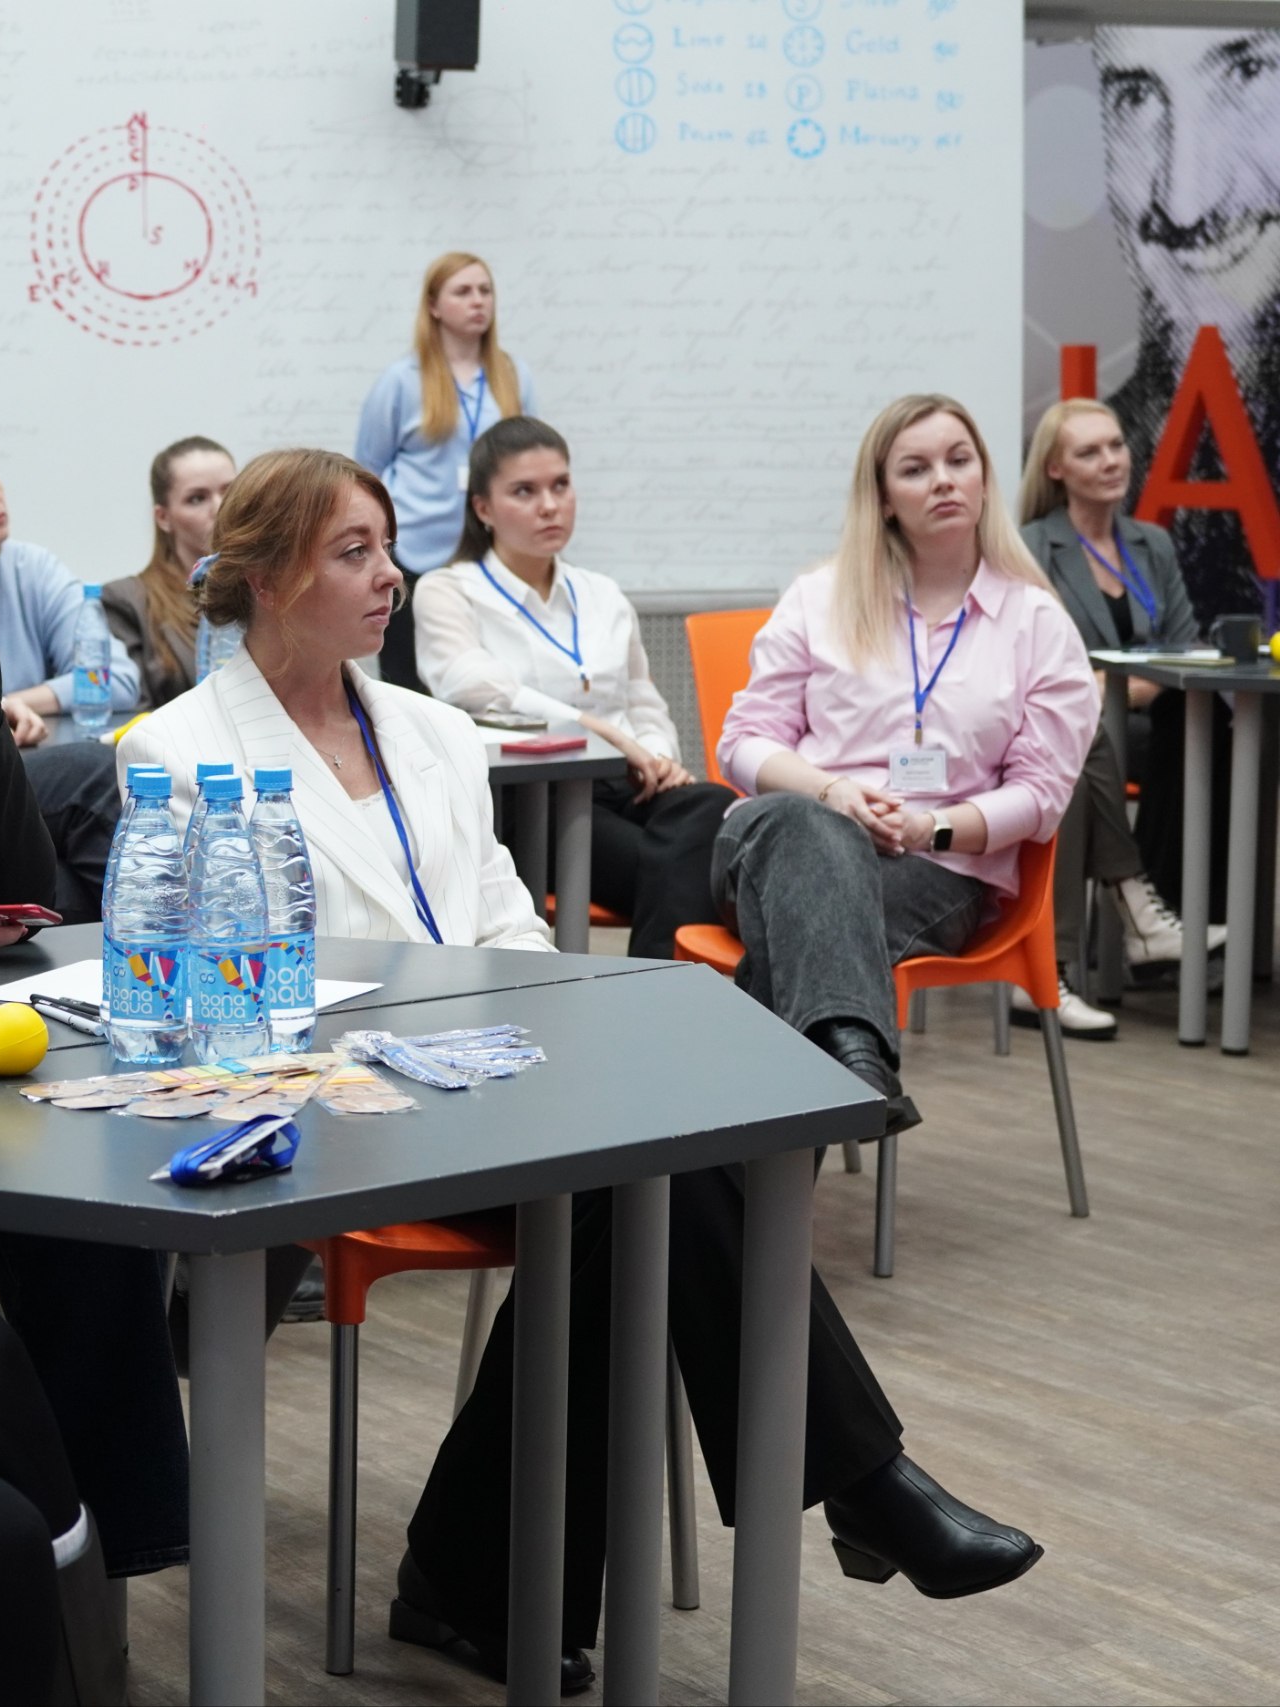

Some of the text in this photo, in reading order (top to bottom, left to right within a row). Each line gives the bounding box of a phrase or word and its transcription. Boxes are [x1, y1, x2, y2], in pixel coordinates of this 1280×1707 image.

[673, 25, 725, 48] Lime
[843, 30, 900, 55] Gold
[676, 71, 724, 97] Soda
[839, 125, 921, 152] Mercury
[149, 225, 163, 245] S
[113, 1001, 152, 1016] aqua
[200, 1006, 245, 1022] aqua
